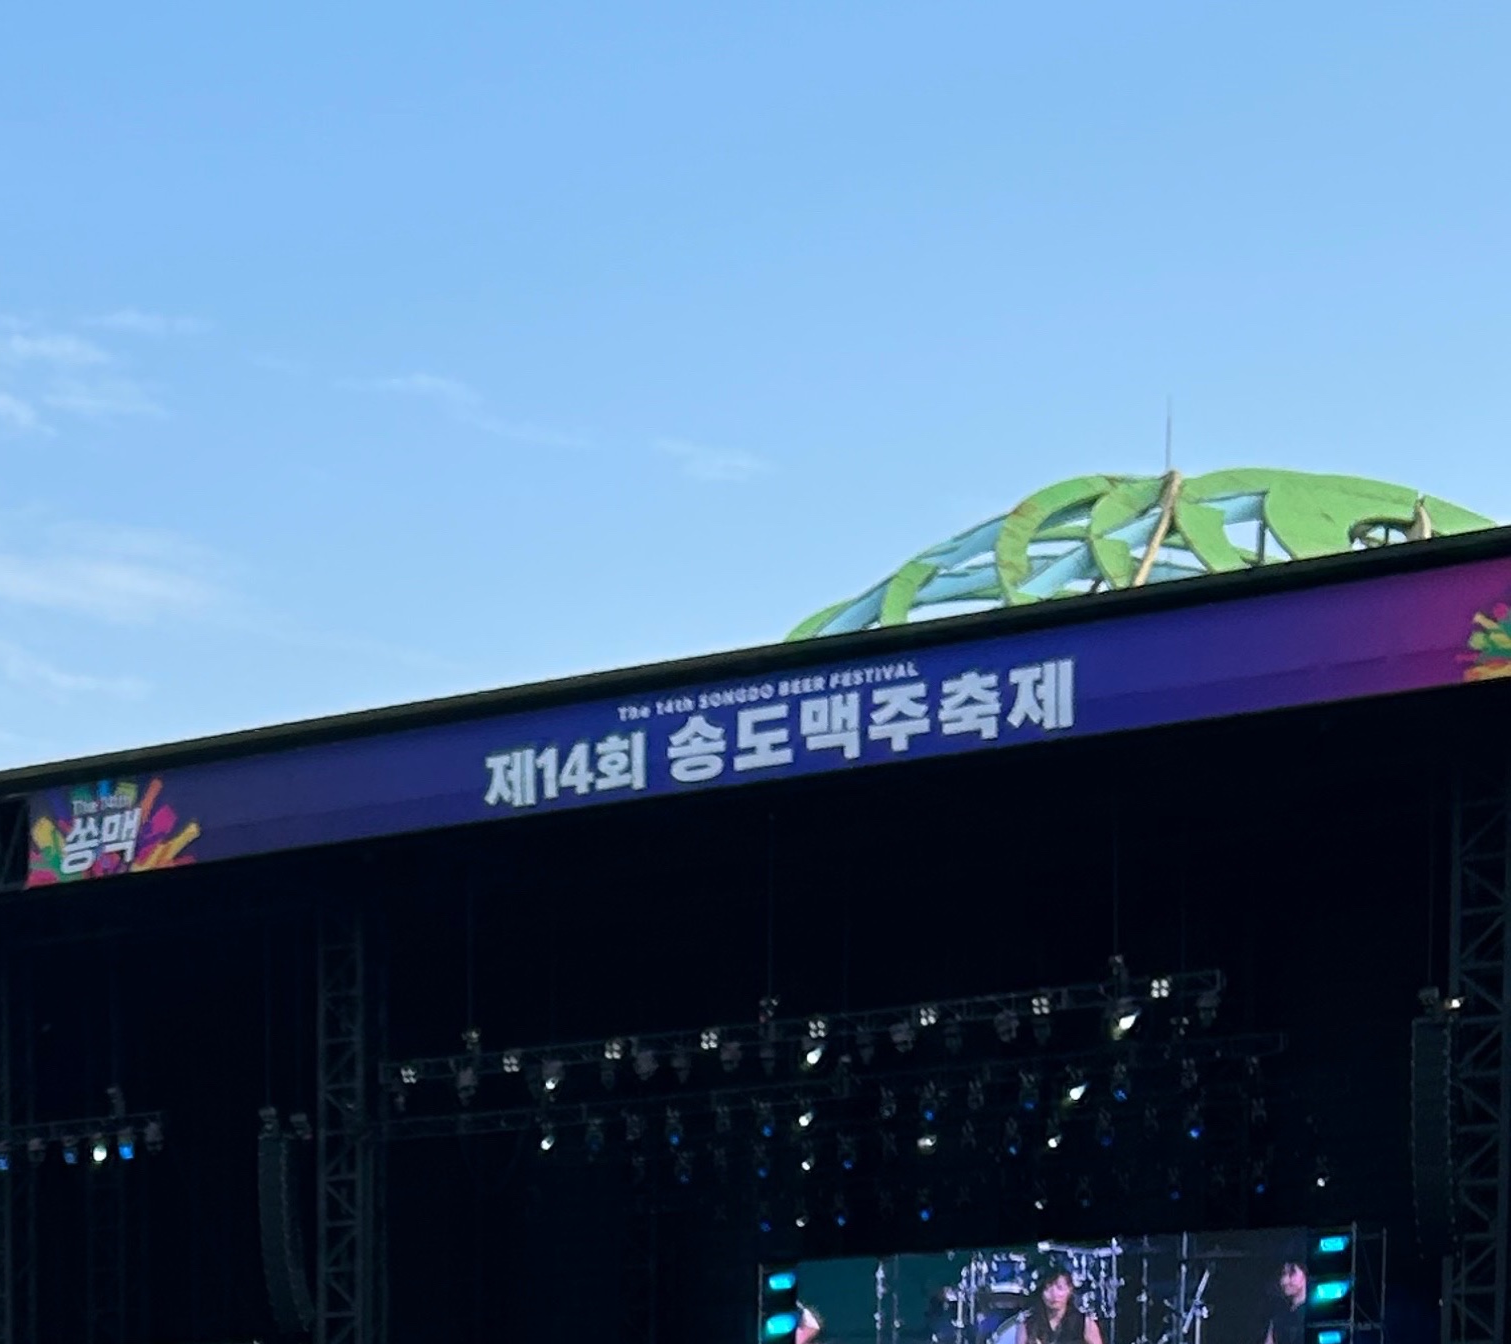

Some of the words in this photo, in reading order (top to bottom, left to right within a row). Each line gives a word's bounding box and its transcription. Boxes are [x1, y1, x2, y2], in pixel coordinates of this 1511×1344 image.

[618, 705, 651, 722] The
[655, 697, 694, 716] 14th
[698, 682, 775, 710] SONGDO
[778, 675, 825, 697] BEER
[829, 661, 919, 689] FESTIVAL
[485, 731, 647, 807] 제14회
[667, 658, 1074, 783] 송도맥주축제
[60, 807, 142, 874] 쏭맥
